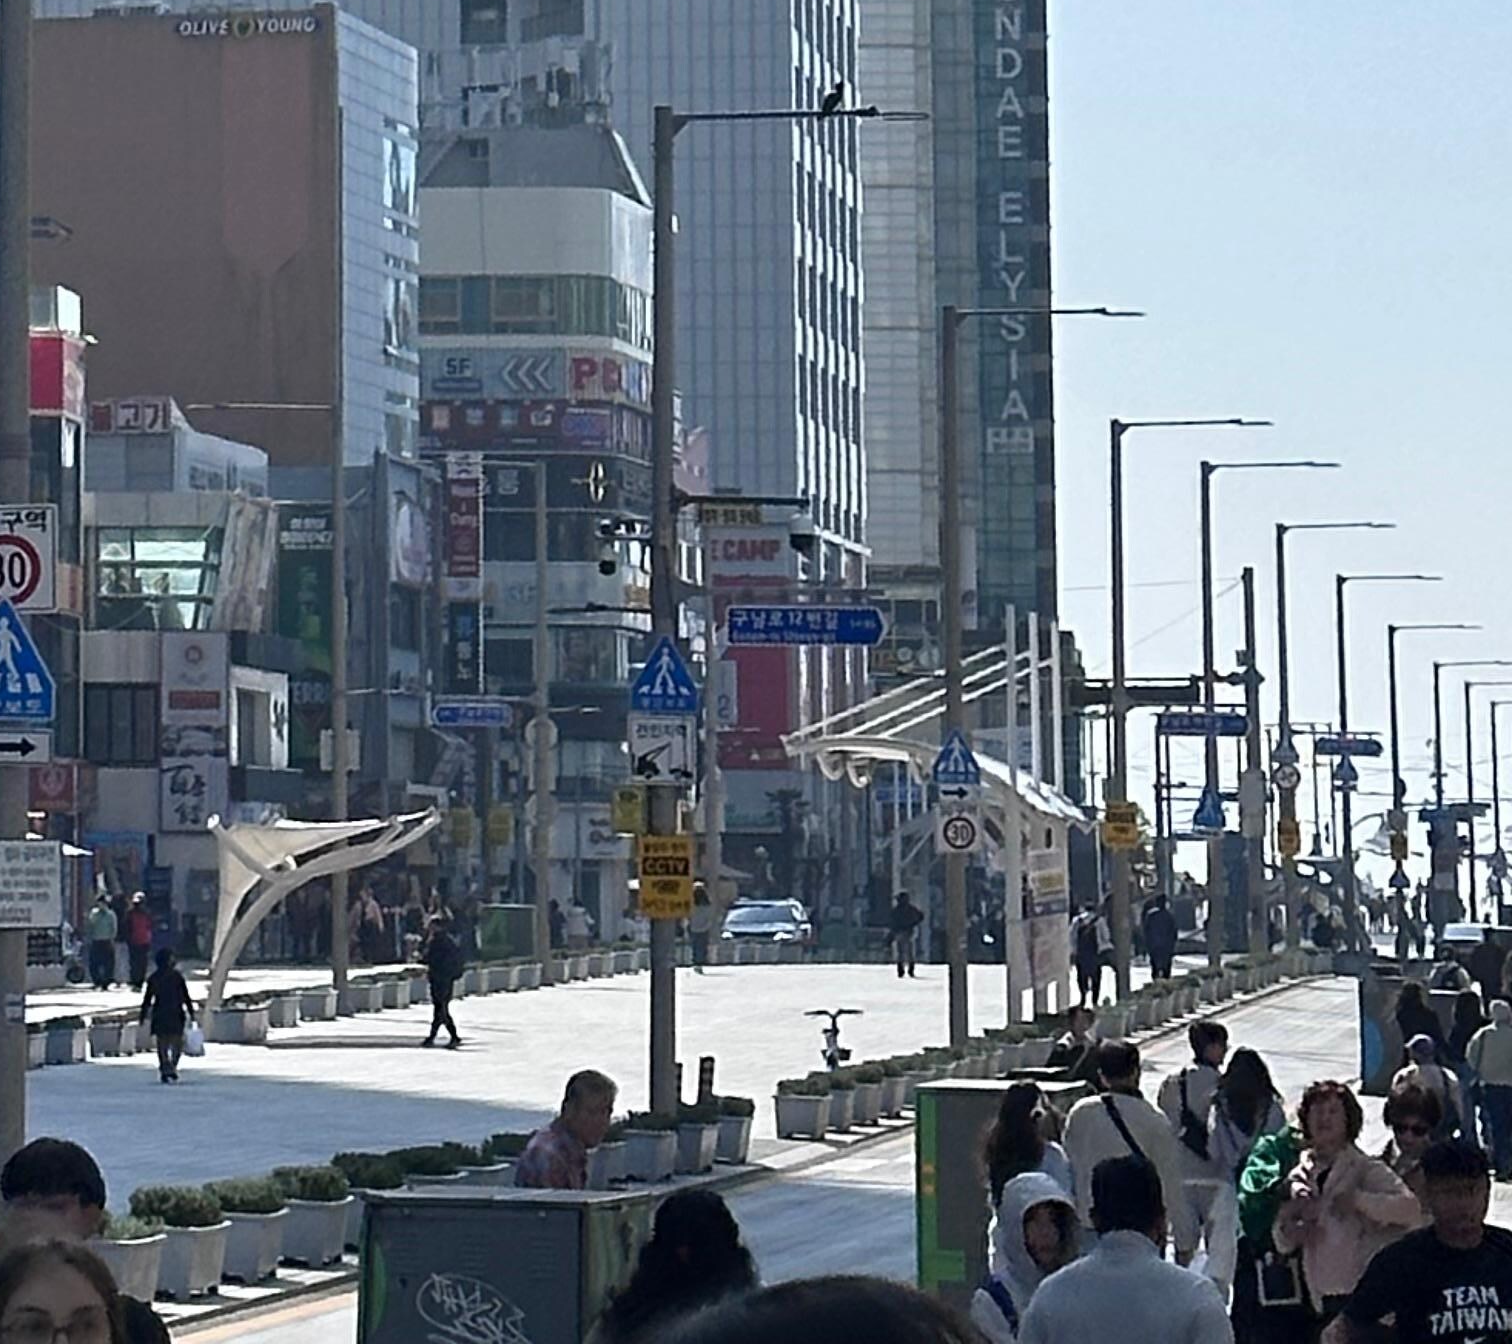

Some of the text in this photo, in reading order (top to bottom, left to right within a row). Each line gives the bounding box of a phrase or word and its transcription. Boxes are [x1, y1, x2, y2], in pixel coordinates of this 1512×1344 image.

[179, 16, 317, 37] OLIVE YOUNG
[997, 191, 1030, 421] ELYSIA
[0, 510, 47, 533] 구역
[723, 538, 781, 562] CAMP
[949, 823, 970, 841] 30
[644, 857, 689, 875] CCTV
[1442, 1285, 1500, 1309] TEAM
